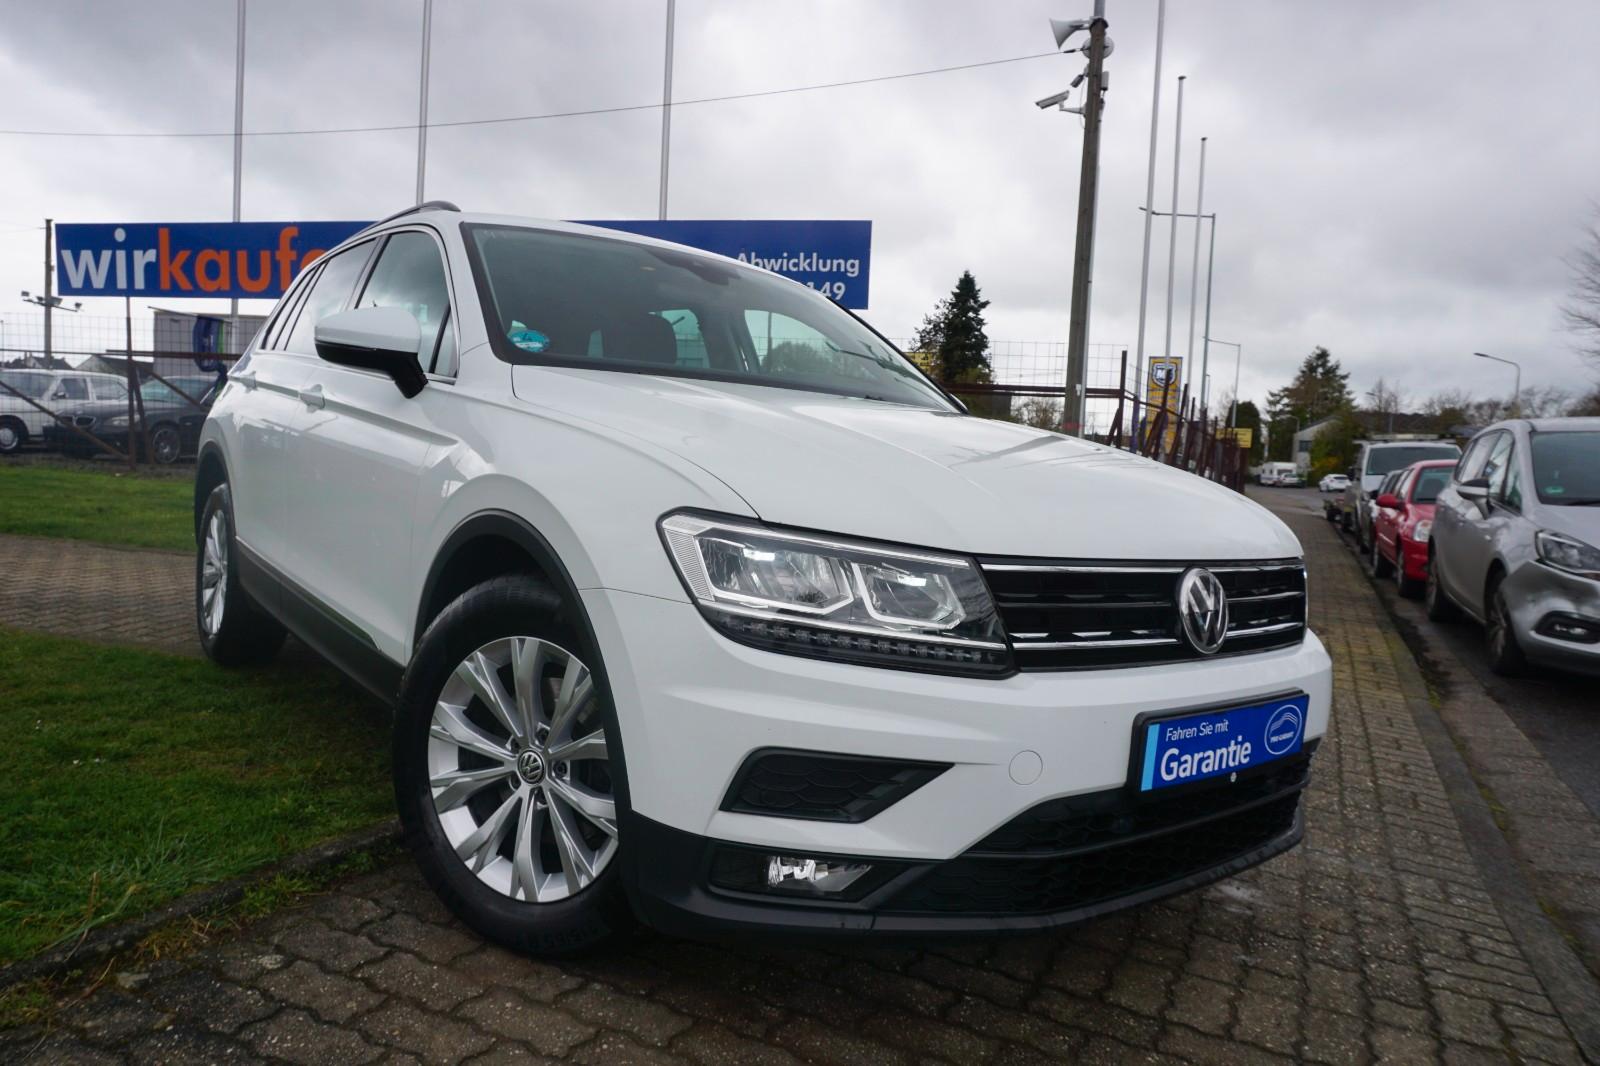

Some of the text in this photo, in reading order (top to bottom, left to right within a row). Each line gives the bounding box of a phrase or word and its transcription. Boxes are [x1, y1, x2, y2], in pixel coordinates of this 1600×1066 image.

[1165, 719, 1229, 742] Fahren Sie mit
[1160, 735, 1252, 782] Garantie
